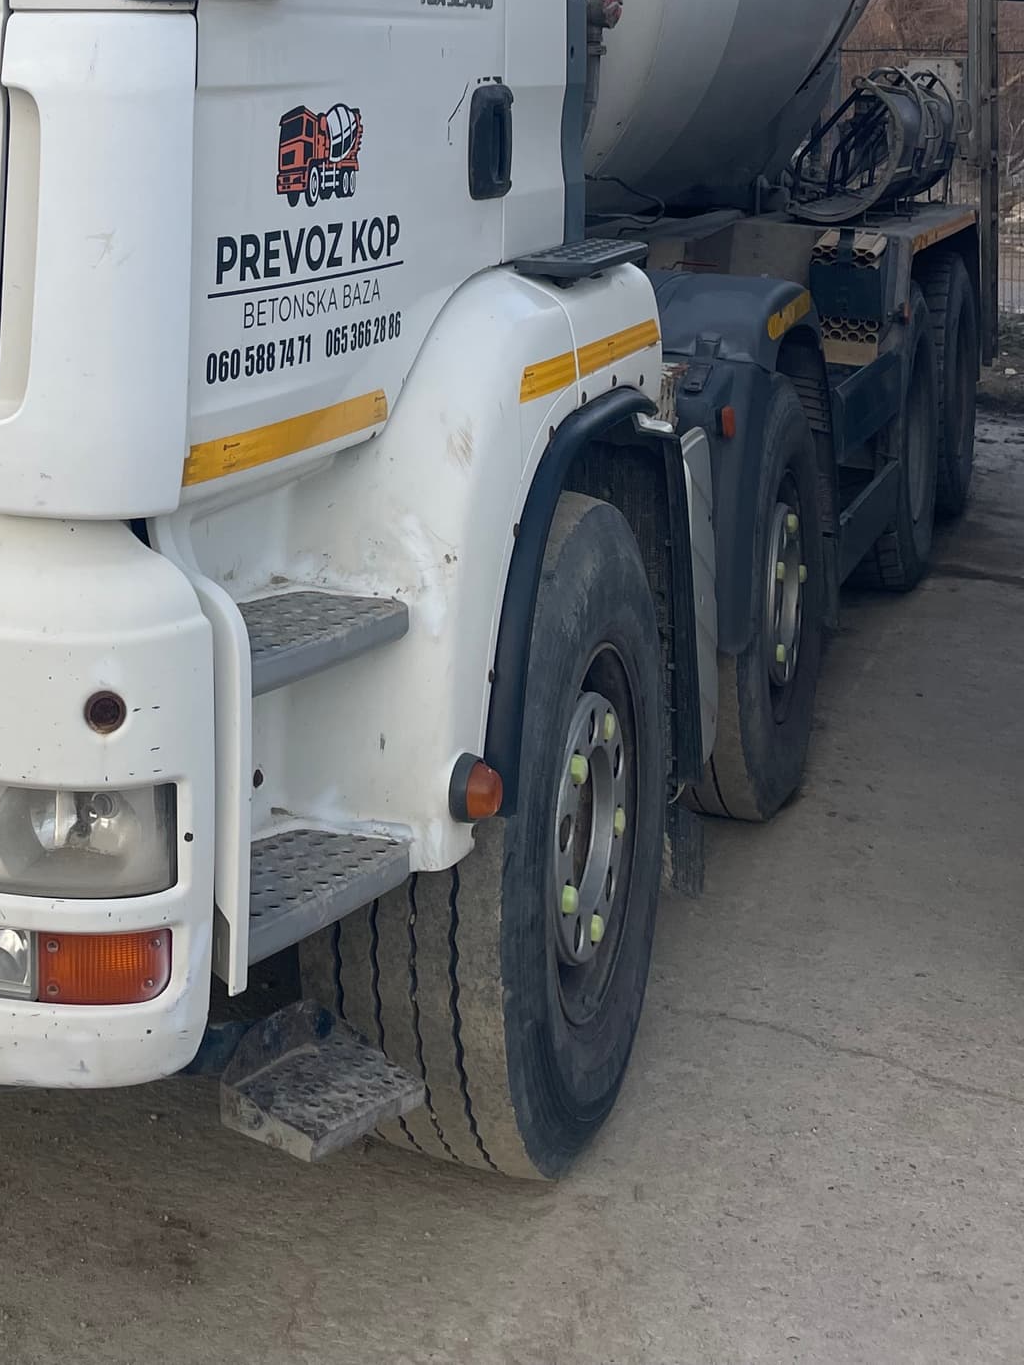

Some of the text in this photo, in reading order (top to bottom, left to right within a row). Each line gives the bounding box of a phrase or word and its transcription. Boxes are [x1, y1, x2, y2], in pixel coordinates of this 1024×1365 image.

[215, 214, 401, 285] PREVOZ KOP
[243, 277, 381, 329] BETONSKA BAZA
[206, 310, 402, 384] 060 588 74 71 065 366 28 86
